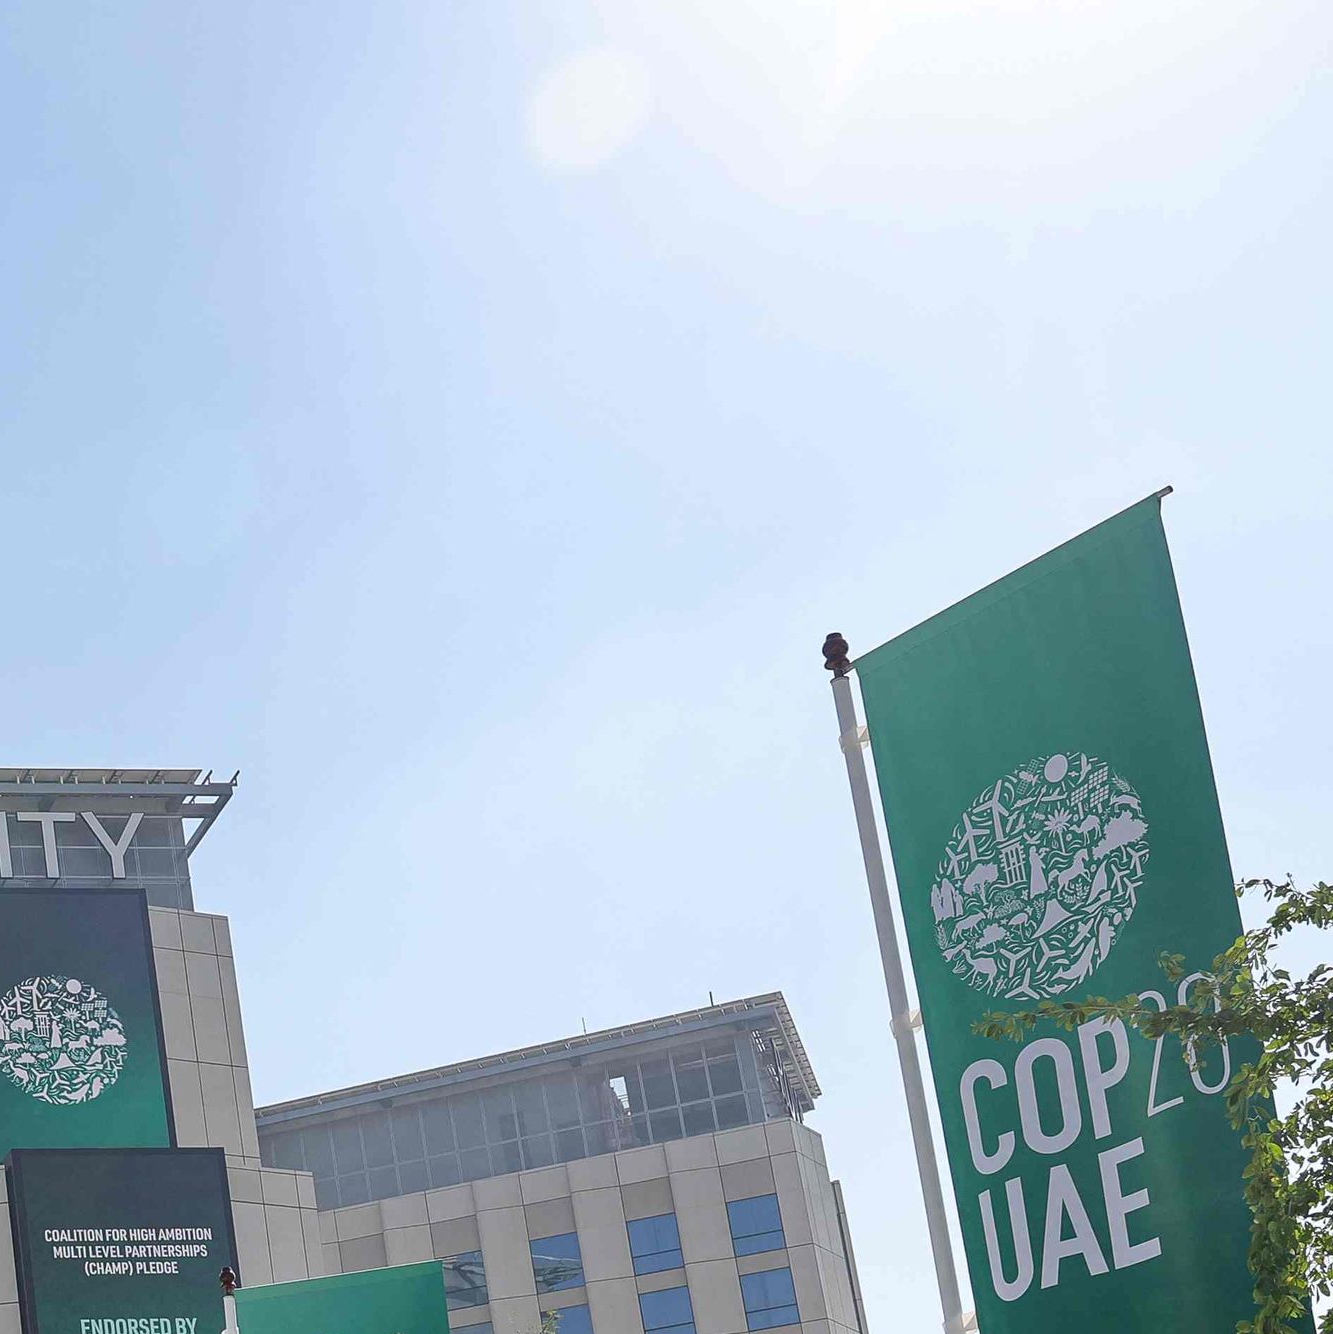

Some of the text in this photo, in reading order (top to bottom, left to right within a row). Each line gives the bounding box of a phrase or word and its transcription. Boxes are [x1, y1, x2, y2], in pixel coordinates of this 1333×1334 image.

[978, 1137, 1162, 1301] UAE
[44, 1228, 213, 1242] COALITION FOR HIGH AMBITION
[53, 1244, 208, 1259] MULTI LEVEL PARTNERSHIPS
[84, 1261, 179, 1276] (CHAMP) PLEDGE
